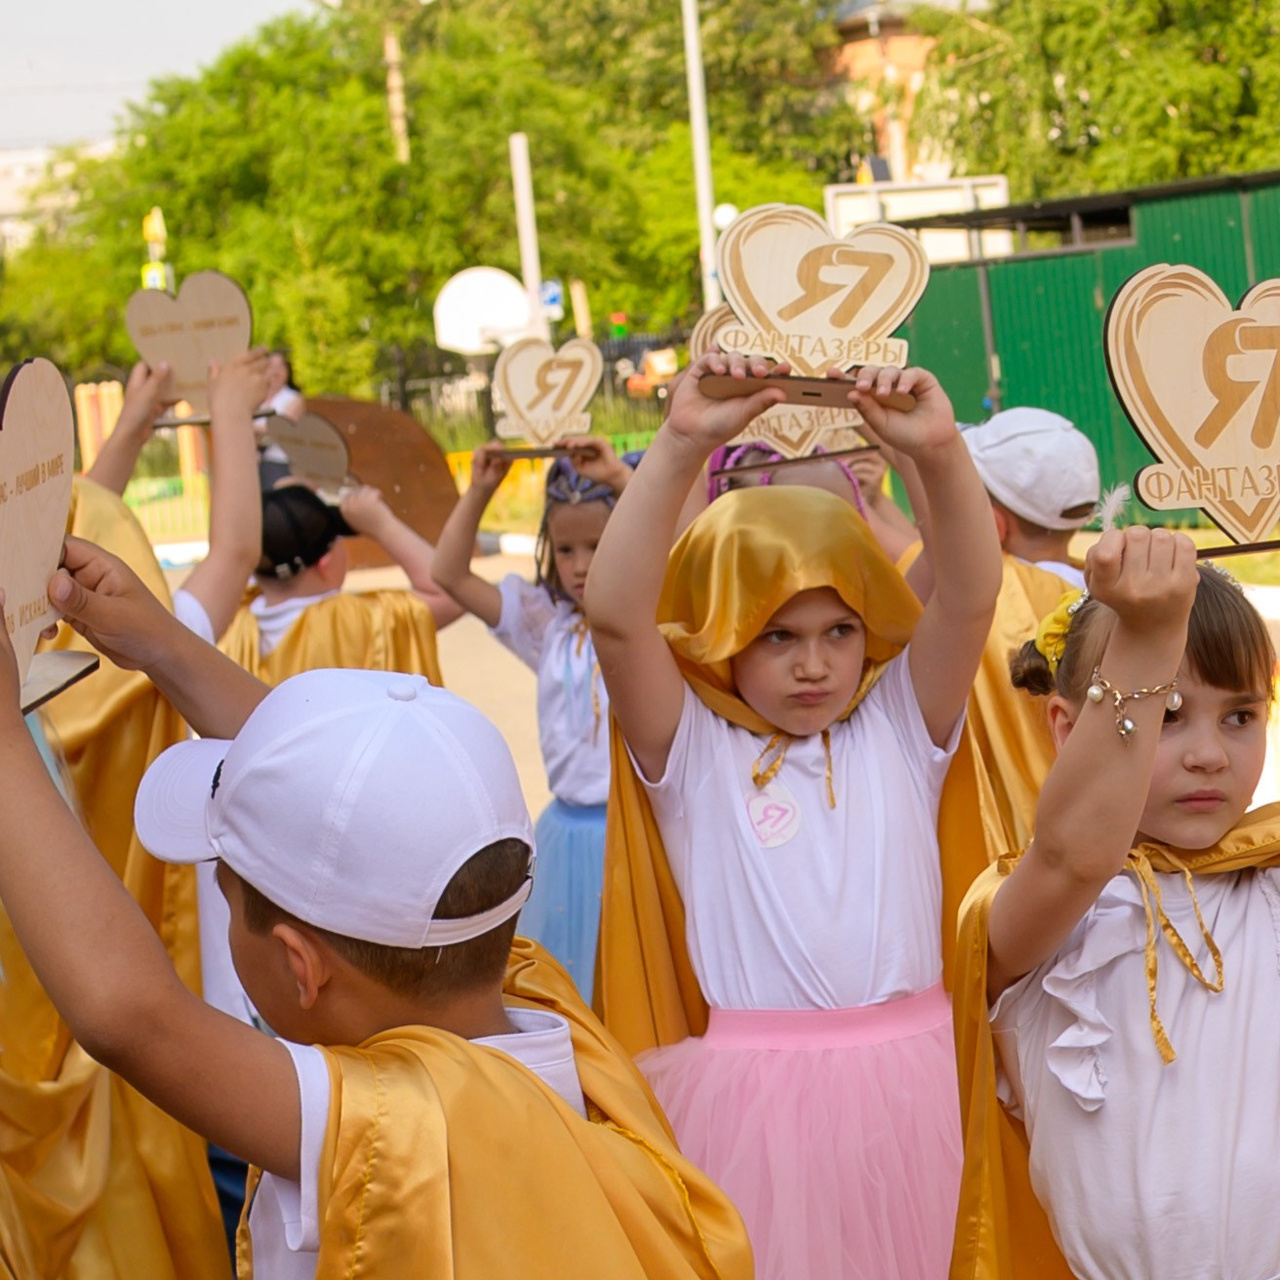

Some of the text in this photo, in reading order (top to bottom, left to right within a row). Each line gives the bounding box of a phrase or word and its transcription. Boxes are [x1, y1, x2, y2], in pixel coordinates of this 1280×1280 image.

[777, 243, 895, 329] Я
[722, 328, 904, 365] ФАНТАЗЁРЫ
[526, 358, 584, 412] Я
[757, 803, 789, 828] Я
